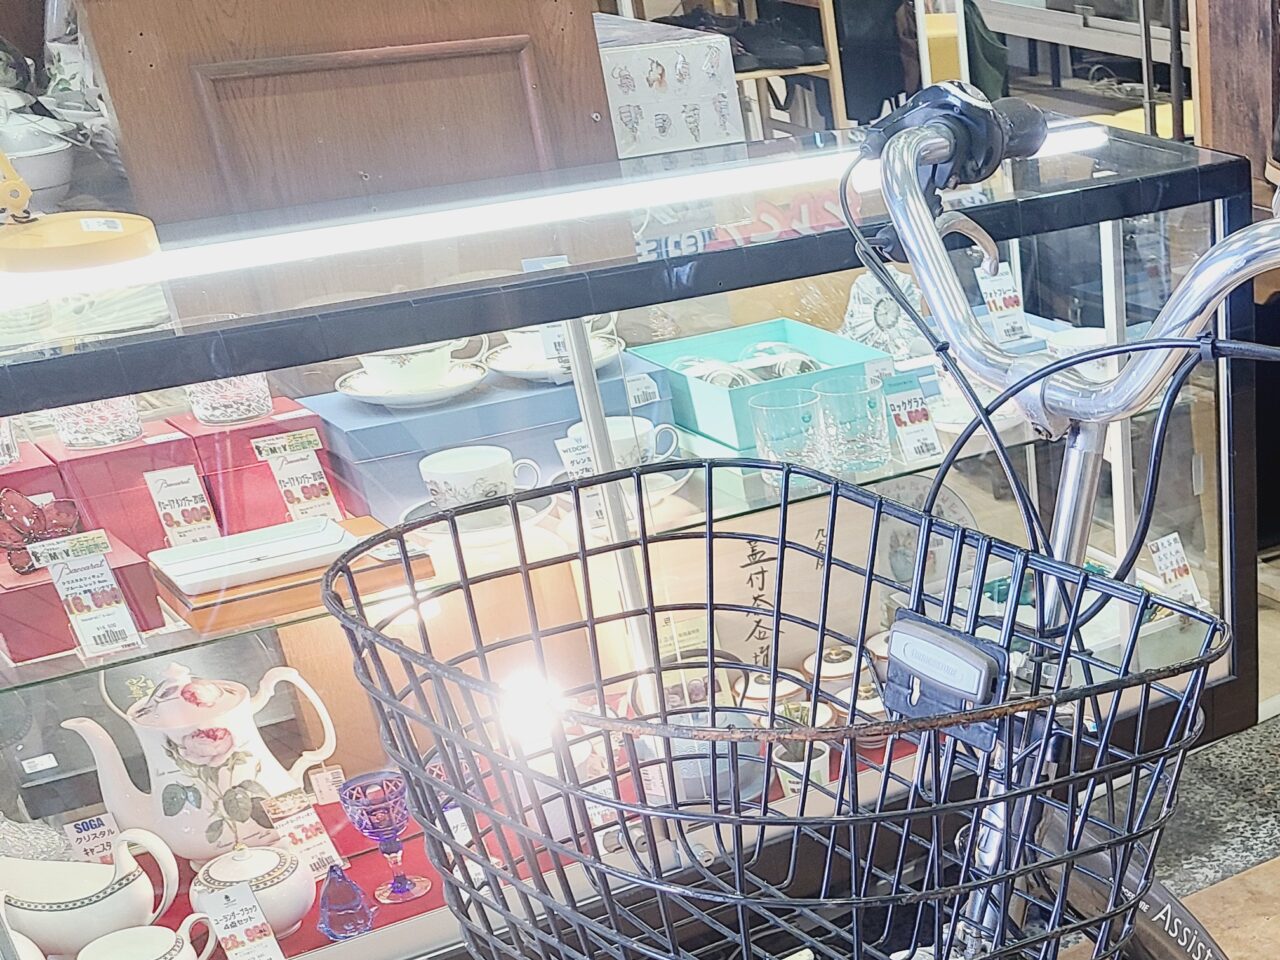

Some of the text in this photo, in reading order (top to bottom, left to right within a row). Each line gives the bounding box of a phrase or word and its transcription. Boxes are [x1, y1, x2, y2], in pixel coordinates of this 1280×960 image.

[889, 396, 927, 412] ロックグラス
[52, 559, 104, 584] Baccarat
[73, 817, 105, 834] SOGA
[75, 828, 115, 845] クリスタル
[223, 916, 256, 930] 4点セット
